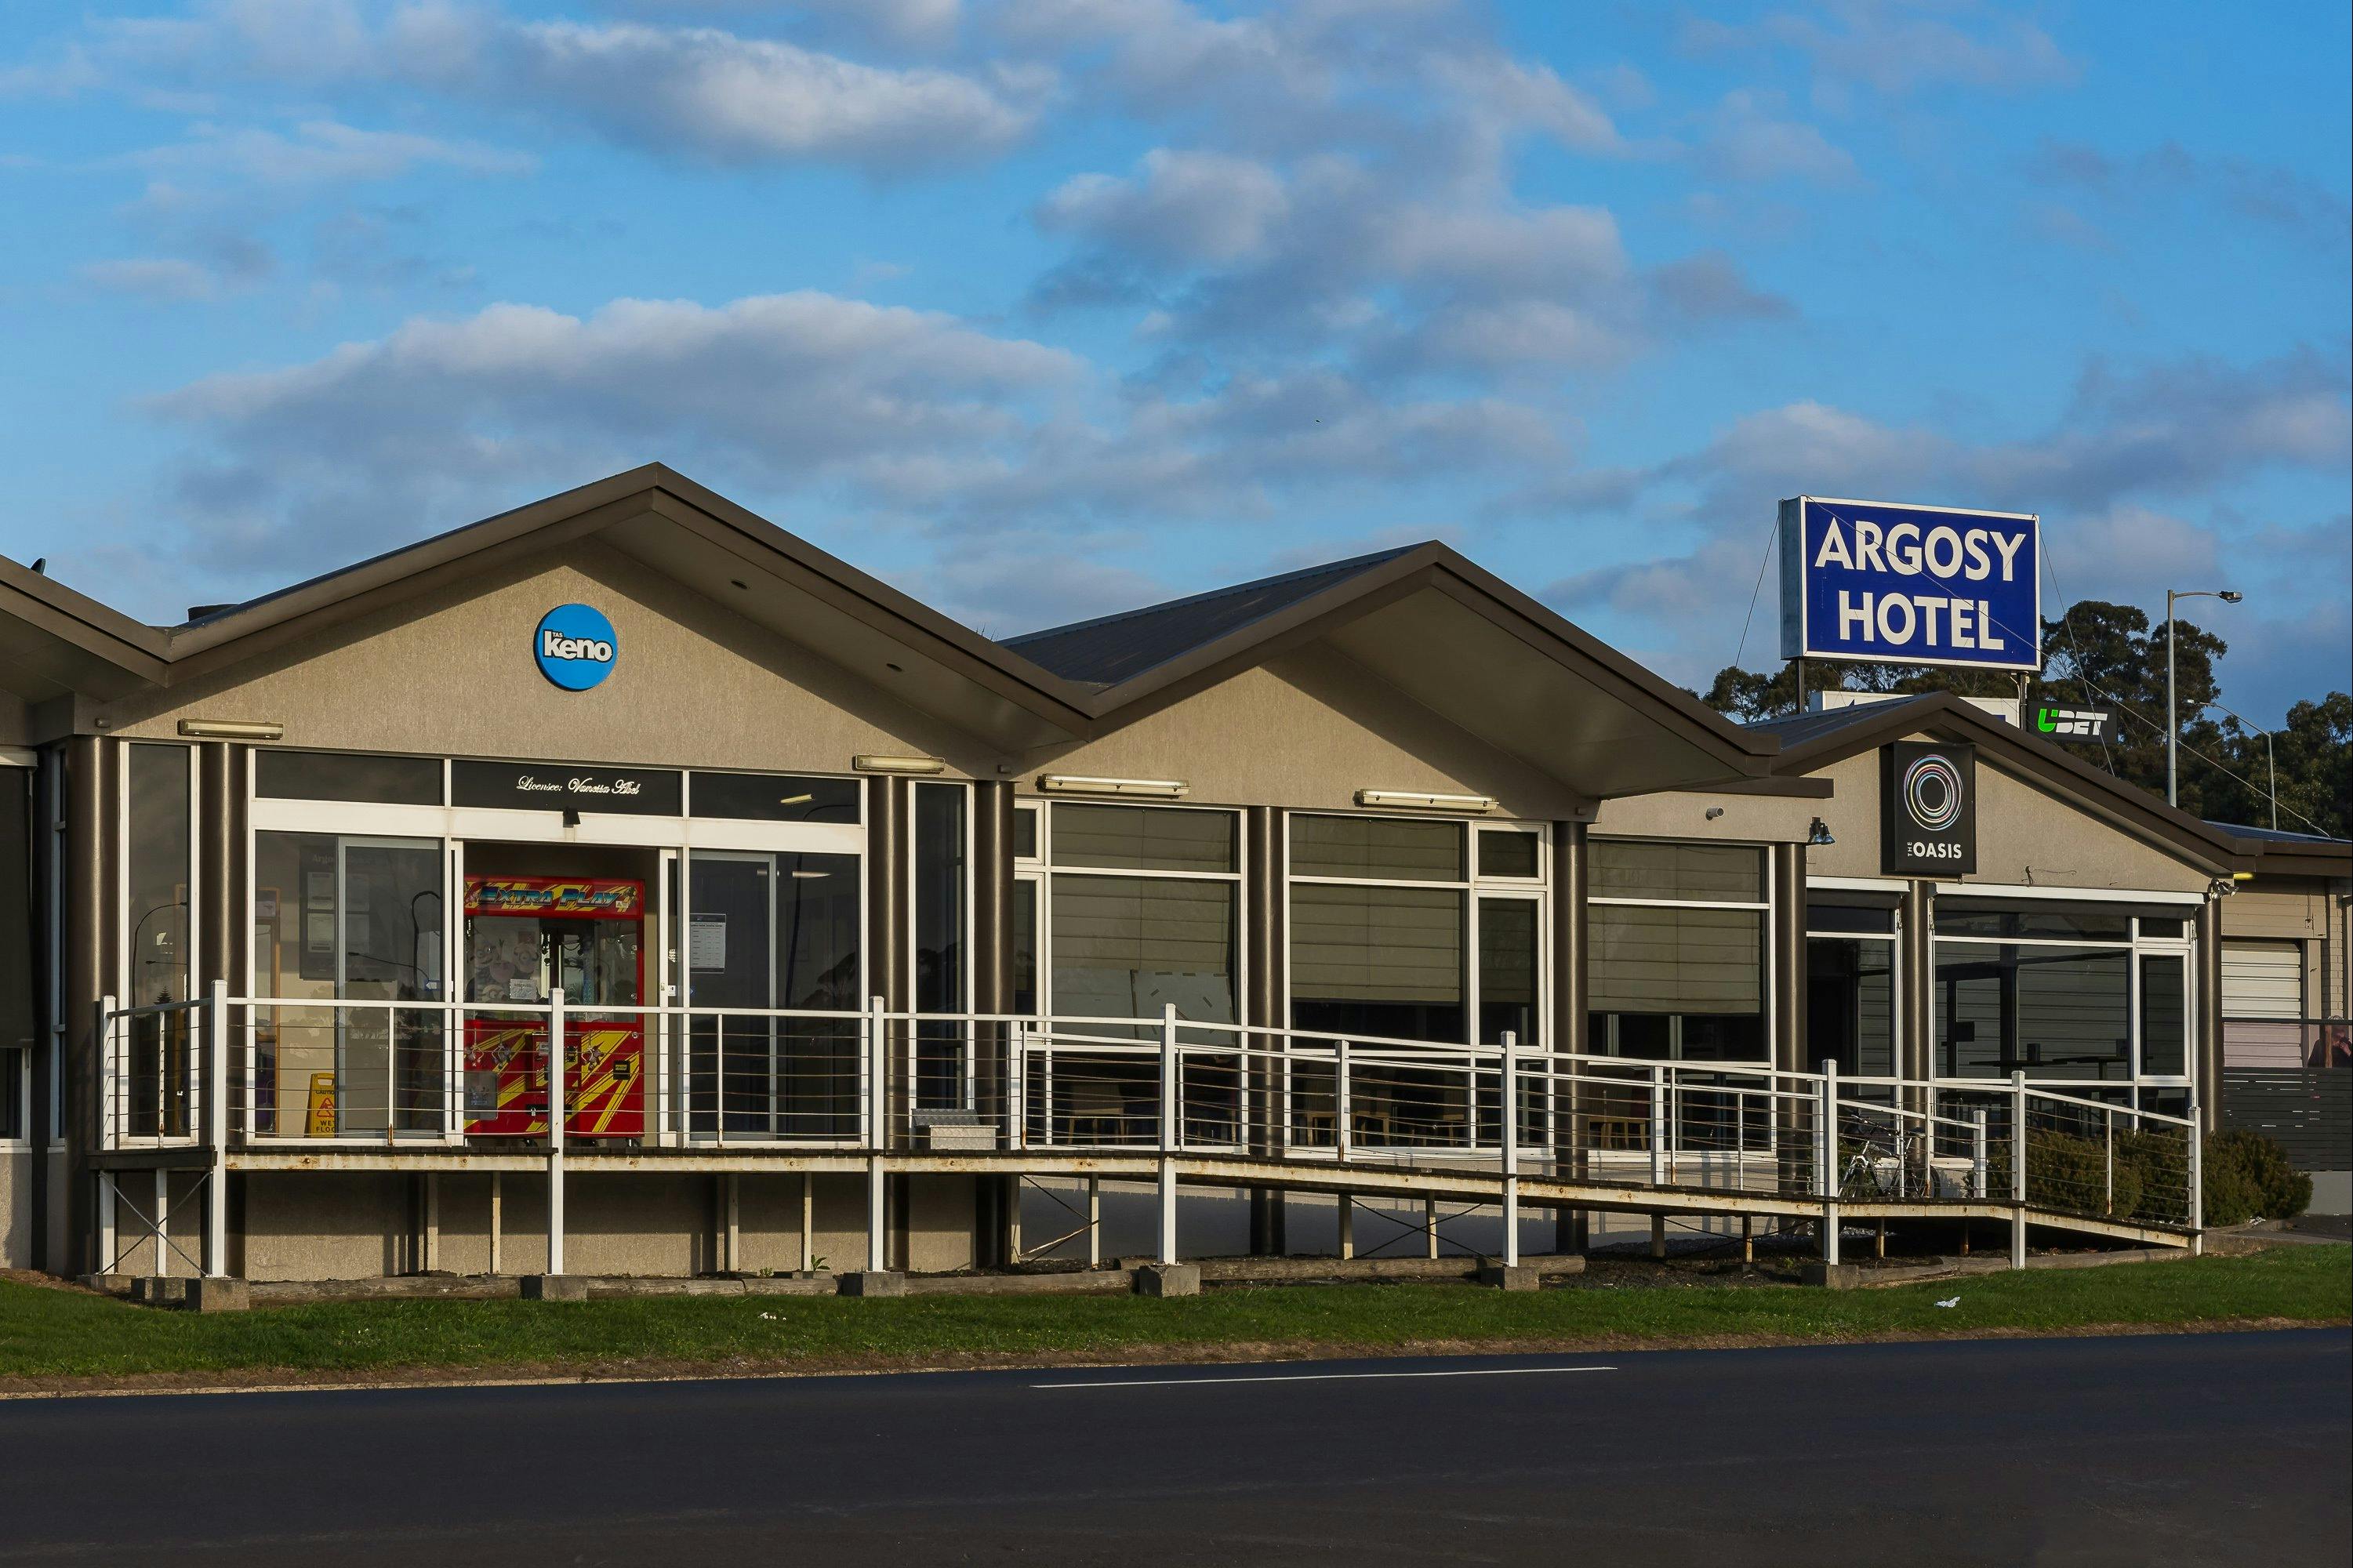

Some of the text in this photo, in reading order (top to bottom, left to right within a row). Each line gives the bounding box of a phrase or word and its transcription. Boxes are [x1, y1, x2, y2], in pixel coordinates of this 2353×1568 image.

[1814, 516, 2027, 583] ARGOSY
[1838, 590, 2005, 652] HOTEL
[544, 630, 613, 662] keno
[516, 775, 563, 792] Licensee:
[1913, 841, 1962, 858] OASIS
